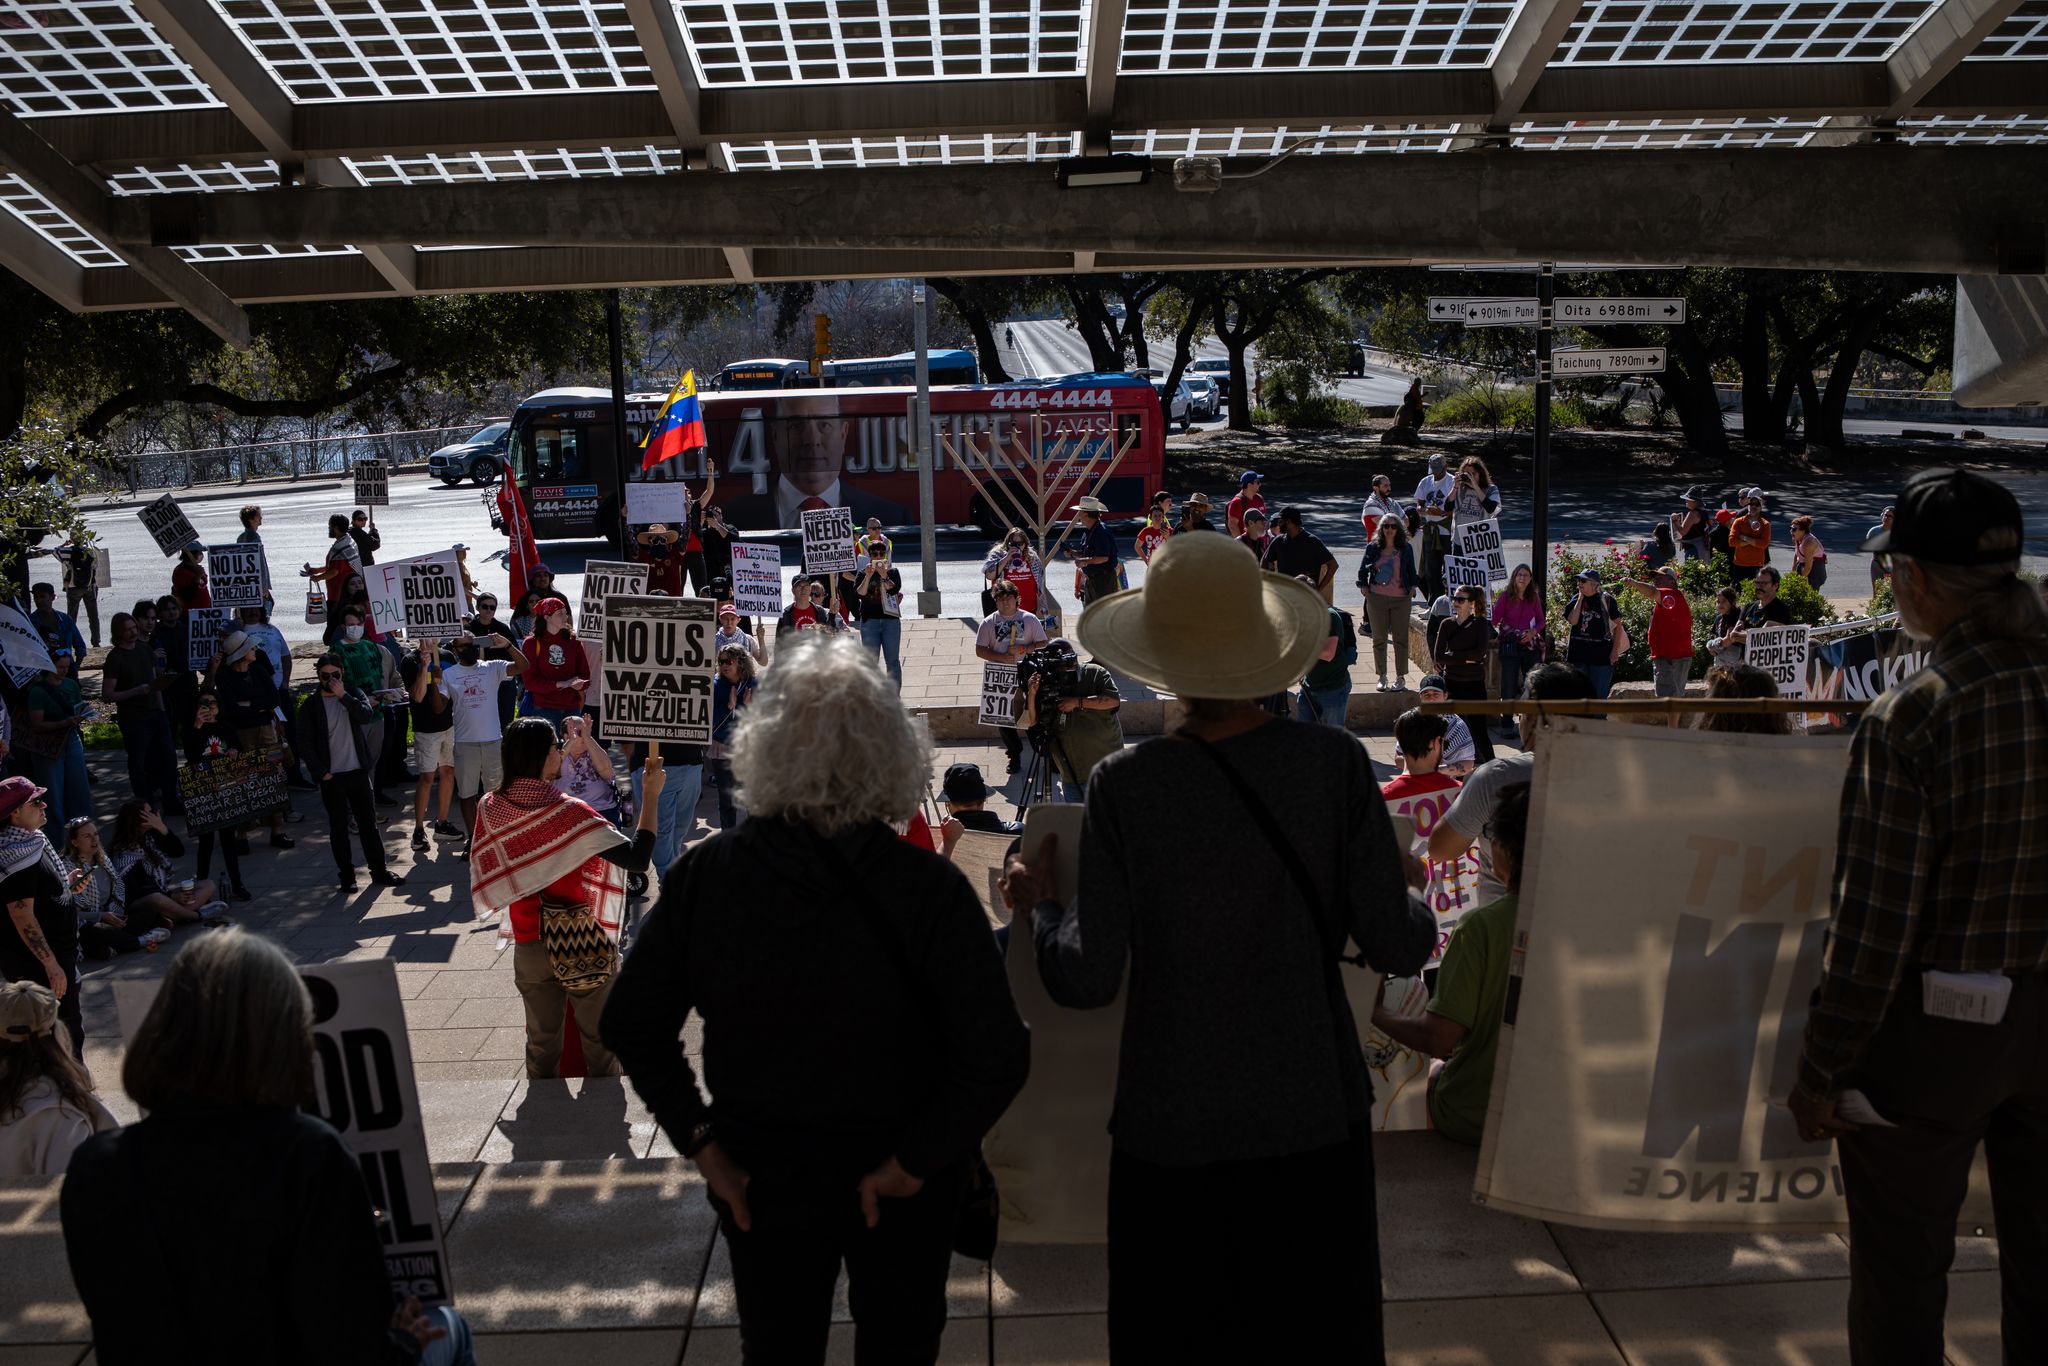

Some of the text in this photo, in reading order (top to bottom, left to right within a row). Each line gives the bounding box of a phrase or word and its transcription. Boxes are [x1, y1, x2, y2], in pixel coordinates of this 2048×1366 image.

[1481, 306, 1534, 319] 9019mi Pune
[1565, 304, 1650, 316] Oita 6988mi
[1558, 355, 1645, 371] Taichung 7890mi
[990, 390, 1113, 408] 444-4444
[728, 408, 771, 494] 4
[1045, 444, 1066, 456] AW
[355, 467, 386, 481] BLOOD
[356, 483, 388, 497] FOR OIL
[535, 488, 564, 497] DAVIS
[144, 500, 165, 516] NO
[534, 500, 599, 511] 444-4444
[145, 502, 180, 533] BLOOD
[804, 513, 849, 522] PEOPLE'S
[155, 528, 178, 548] FOR
[173, 519, 192, 537] OIL
[805, 518, 851, 542] NEEDS
[1467, 523, 1490, 534] NO
[806, 542, 841, 552] NOT
[1463, 531, 1499, 554] BLOOD
[210, 554, 259, 575] NO U.S.
[807, 550, 853, 563] WAR MACHINE
[1455, 558, 1478, 568] NO
[1487, 552, 1504, 570] OIL
[411, 564, 444, 576] NO
[1449, 566, 1486, 587] BLOOD
[211, 575, 260, 587] WAR
[403, 576, 456, 600] BLOOD
[584, 574, 610, 600] NO
[212, 585, 260, 600] VENEZUELA
[739, 585, 781, 596] CAPITALISM
[198, 610, 222, 618] NO
[405, 603, 460, 625] FOR OIL
[767, 601, 781, 612] ALL
[192, 619, 224, 638] BLOO
[606, 620, 711, 668] NO U.S.
[1751, 629, 1806, 648] MONEY FOR
[190, 640, 211, 658] FOR
[1749, 645, 1805, 667] PEOPLE'S
[604, 670, 711, 696] WAR
[1770, 665, 1795, 684] EDS
[604, 693, 709, 726] VENEZUELA
[604, 724, 708, 739] PARTY FOR SOCIALISM & LIBERATION
[184, 793, 214, 808] ESTADOS
[243, 782, 255, 793] NO
[256, 775, 281, 788] VIENE
[235, 794, 247, 804] EL
[189, 814, 213, 827] VIENE
[250, 792, 289, 811] GASOLINA
